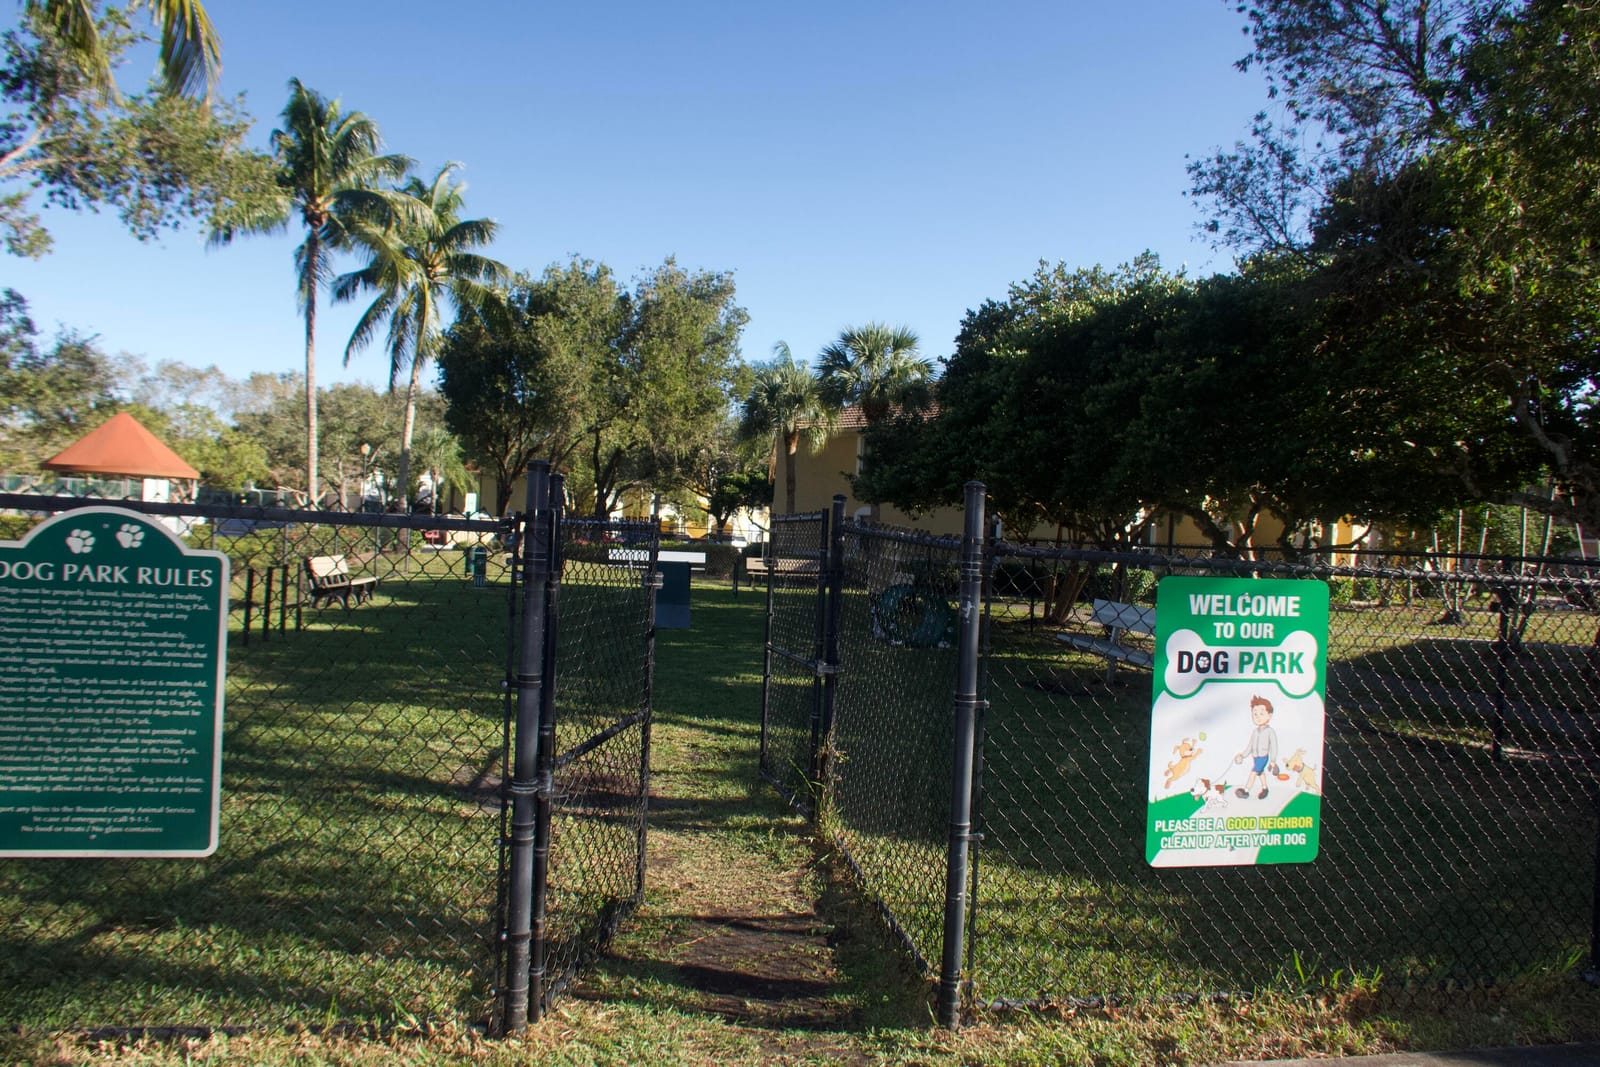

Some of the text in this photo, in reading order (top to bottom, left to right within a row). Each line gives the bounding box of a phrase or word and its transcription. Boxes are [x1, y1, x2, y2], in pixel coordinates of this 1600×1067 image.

[63, 564, 130, 584] PARK
[137, 566, 213, 587] RULES
[1189, 594, 1301, 617] WELCOME
[1214, 622, 1274, 639] TO OUR
[1177, 651, 1304, 674] DOG PARK
[1155, 816, 1313, 832] PLEASE BE A GOOD NEIGHBOR
[1160, 833, 1306, 849] CLEAN UP AFTER YOUR DOG
